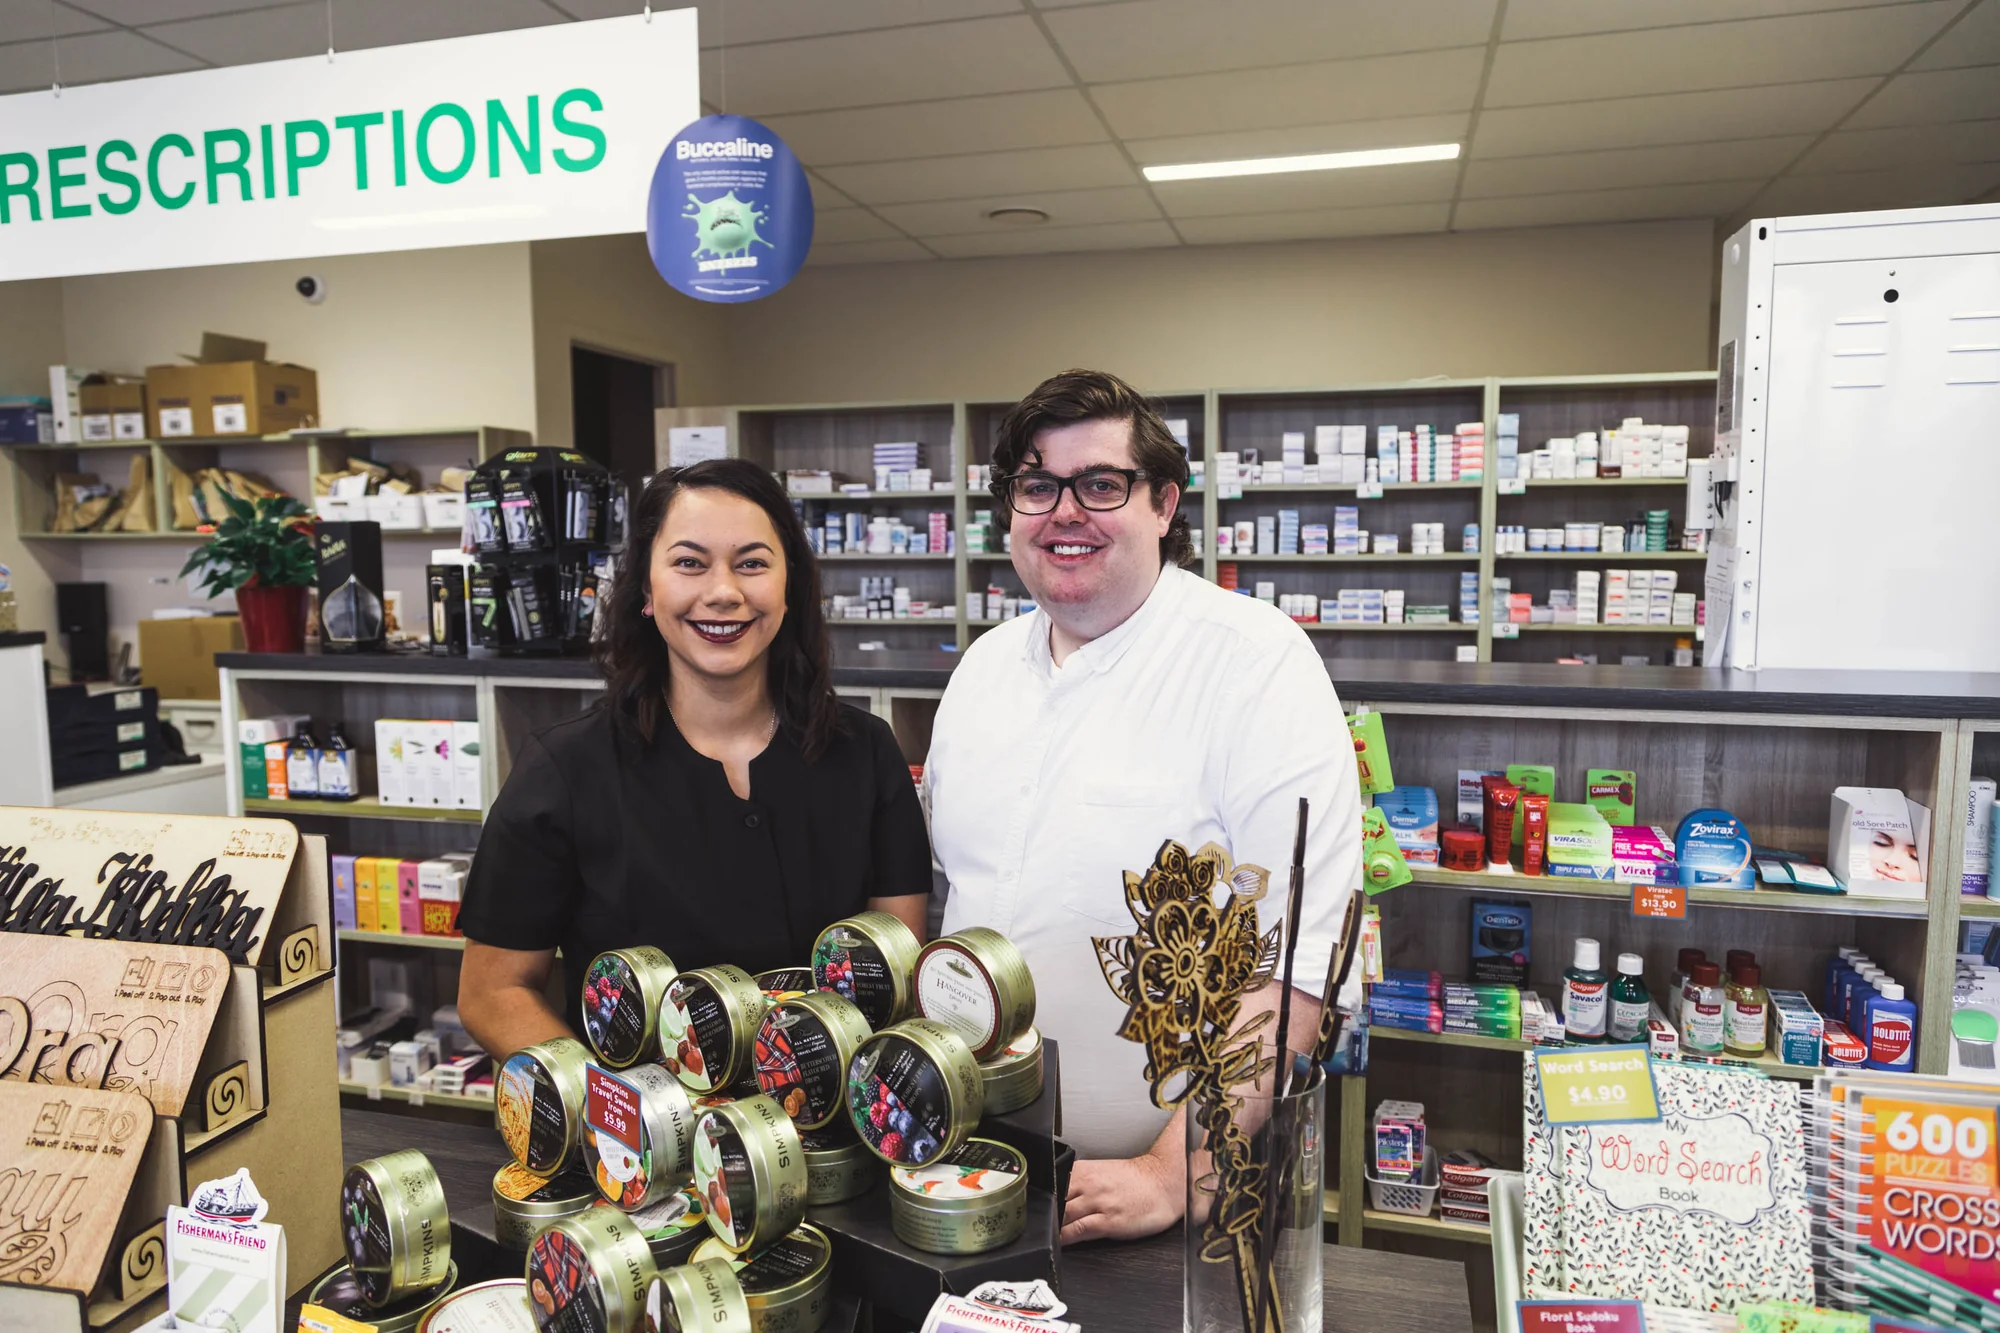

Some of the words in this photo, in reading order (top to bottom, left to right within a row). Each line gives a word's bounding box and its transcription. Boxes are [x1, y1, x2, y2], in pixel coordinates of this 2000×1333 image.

[676, 137, 774, 160] Buccaline
[1591, 786, 1620, 794] CARMEX
[1967, 790, 1977, 827] SHAMPOO
[1391, 815, 1419, 824] Dermal
[1886, 821, 1908, 829] Patch
[1689, 822, 1734, 837] Zovirax
[1614, 842, 1632, 851] FREE
[1555, 865, 1573, 873] TRIPLE
[1622, 866, 1665, 876] Viratac
[1647, 886, 1673, 894] Viratac
[1641, 898, 1677, 909] $13.90
[424, 911, 452, 926] HOT
[1486, 915, 1520, 925] DenTek
[936, 978, 978, 1005] HANGOVER
[1570, 981, 1601, 992] Colgate
[119, 989, 133, 999] Peel
[133, 991, 145, 999] off
[155, 992, 168, 1003] Pop
[168, 994, 181, 1002] out
[191, 995, 207, 1007] Play
[1569, 991, 1603, 1003] Savacol
[698, 1001, 716, 1014] NATURAL
[1375, 1010, 1400, 1019] bonjela
[803, 1034, 824, 1043] NATURAL
[1788, 1034, 1818, 1042] pastilles
[1873, 1026, 1911, 1041] HOLDTITE
[811, 1044, 827, 1052] SWEETS
[1832, 1047, 1863, 1059] HOLDTITE
[800, 1053, 838, 1070] BUTTERSCOTCH
[886, 1072, 895, 1083] ALL
[892, 1049, 908, 1073] NATURAL
[1543, 1059, 1584, 1075] Word
[1589, 1057, 1645, 1072] Search
[893, 1073, 905, 1091] TRAVEL
[903, 1057, 916, 1075] SWEETS
[600, 1077, 629, 1100] Simpkins
[1568, 1084, 1627, 1103] $4.90
[591, 1083, 613, 1101] Travel
[614, 1094, 637, 1116] Sweets
[607, 1101, 623, 1117] from
[604, 1111, 627, 1132] $5.99
[1665, 1119, 1688, 1135] My
[668, 1102, 685, 1174] SIMPKINS
[753, 1103, 791, 1169] SIMPKINS
[1886, 1111, 1988, 1158] 600
[31, 1137, 46, 1147] Peel
[46, 1140, 59, 1149] off
[85, 1144, 99, 1153] out
[109, 1144, 126, 1158] Play
[1598, 1134, 1671, 1175] Word
[1676, 1141, 1763, 1185] Search
[1885, 1153, 1988, 1183] PUZZLES
[1445, 1173, 1483, 1184] Colgate
[1447, 1191, 1485, 1202] Colgate
[1659, 1187, 1700, 1203] Book
[1447, 1209, 1485, 1220] Colgate
[1883, 1187, 2000, 1228] CROSS
[177, 1220, 233, 1243] FISHERMAN'S
[233, 1231, 267, 1250] FRIEND
[417, 1219, 432, 1288] SIMPKINS
[606, 1224, 646, 1302] SIMPKINS
[946, 1304, 1015, 1329] FISHERMAN'S
[1540, 1311, 1574, 1322] Floral
[1576, 1311, 1619, 1322] Sudoku
[1566, 1322, 1596, 1333] Book
